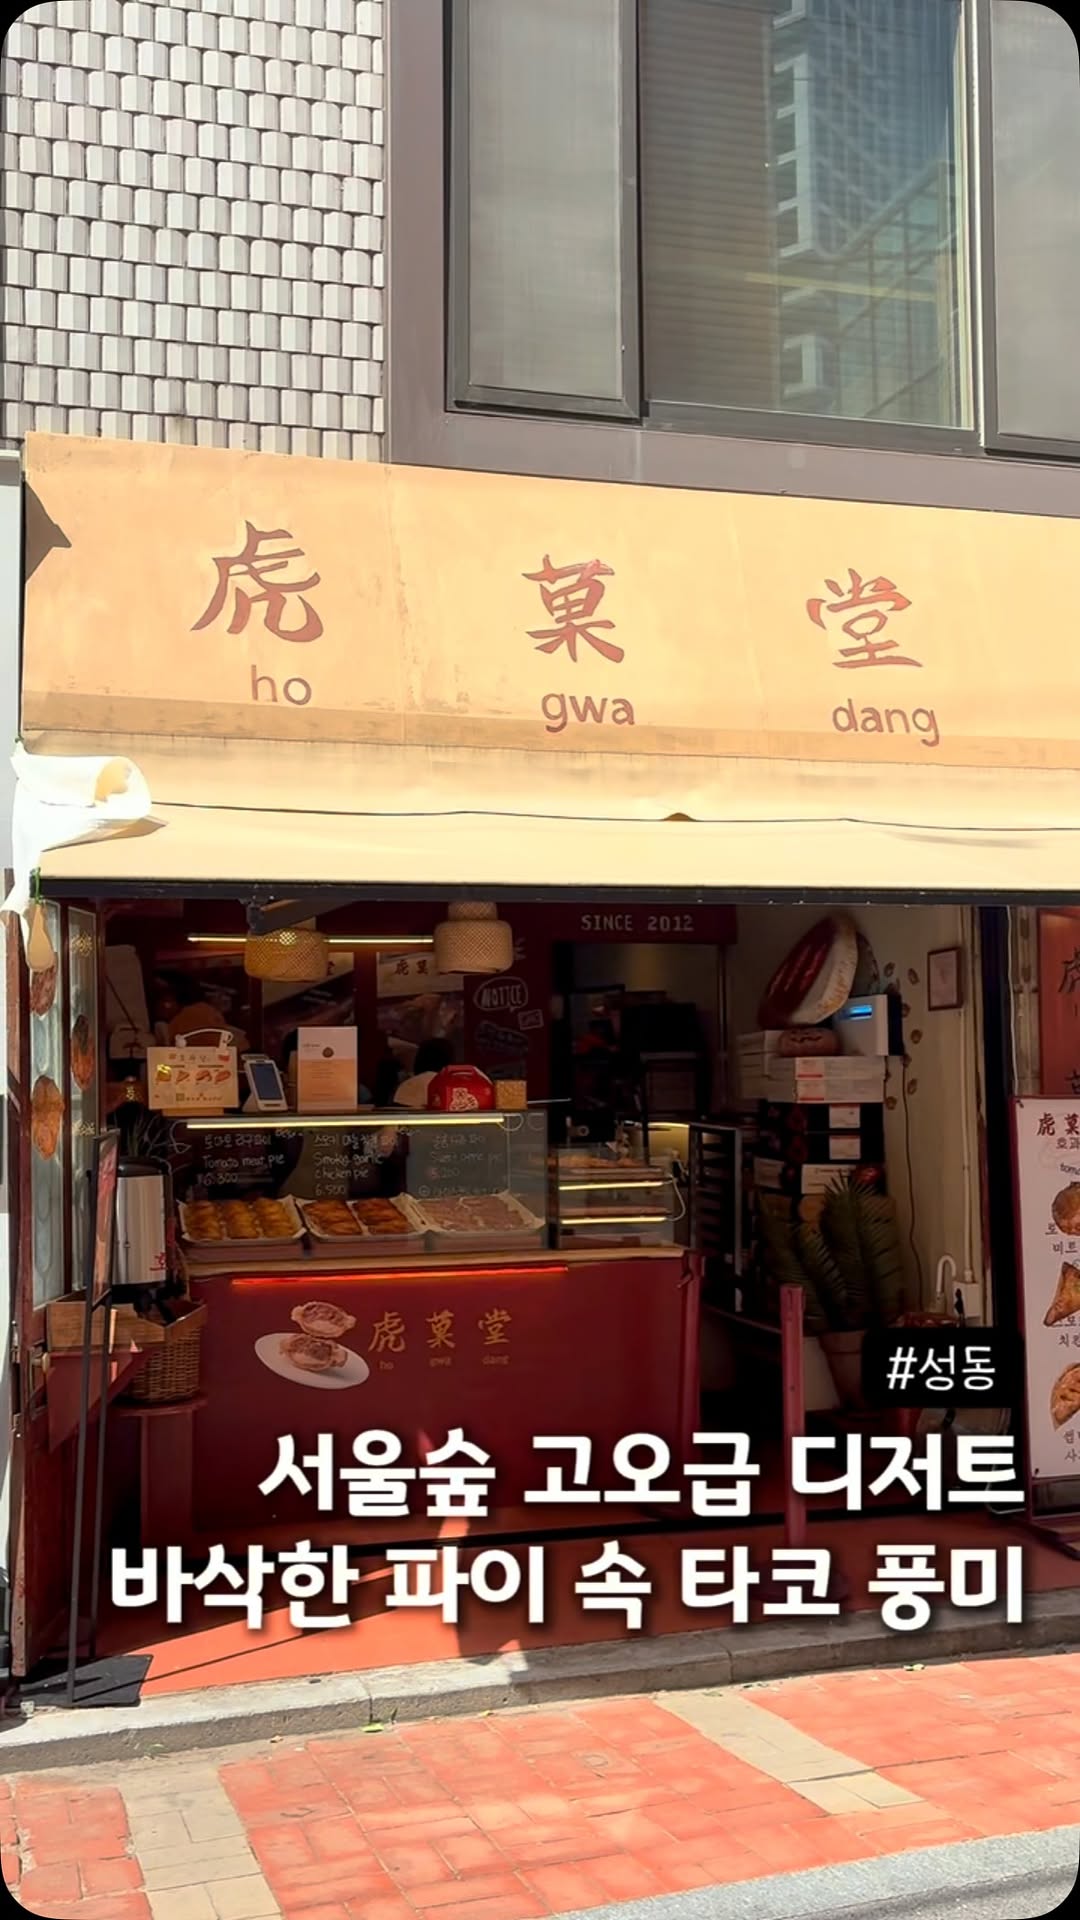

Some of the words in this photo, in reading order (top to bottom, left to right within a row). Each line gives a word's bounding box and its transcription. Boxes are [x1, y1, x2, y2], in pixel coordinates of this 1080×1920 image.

[251, 664, 312, 706] ho
[541, 693, 635, 733] gwa
[832, 698, 940, 747] dang
[581, 914, 633, 931] SINCE
[647, 914, 694, 932] 2012
[202, 1154, 239, 1169] Tomato
[268, 1154, 286, 1168] pie
